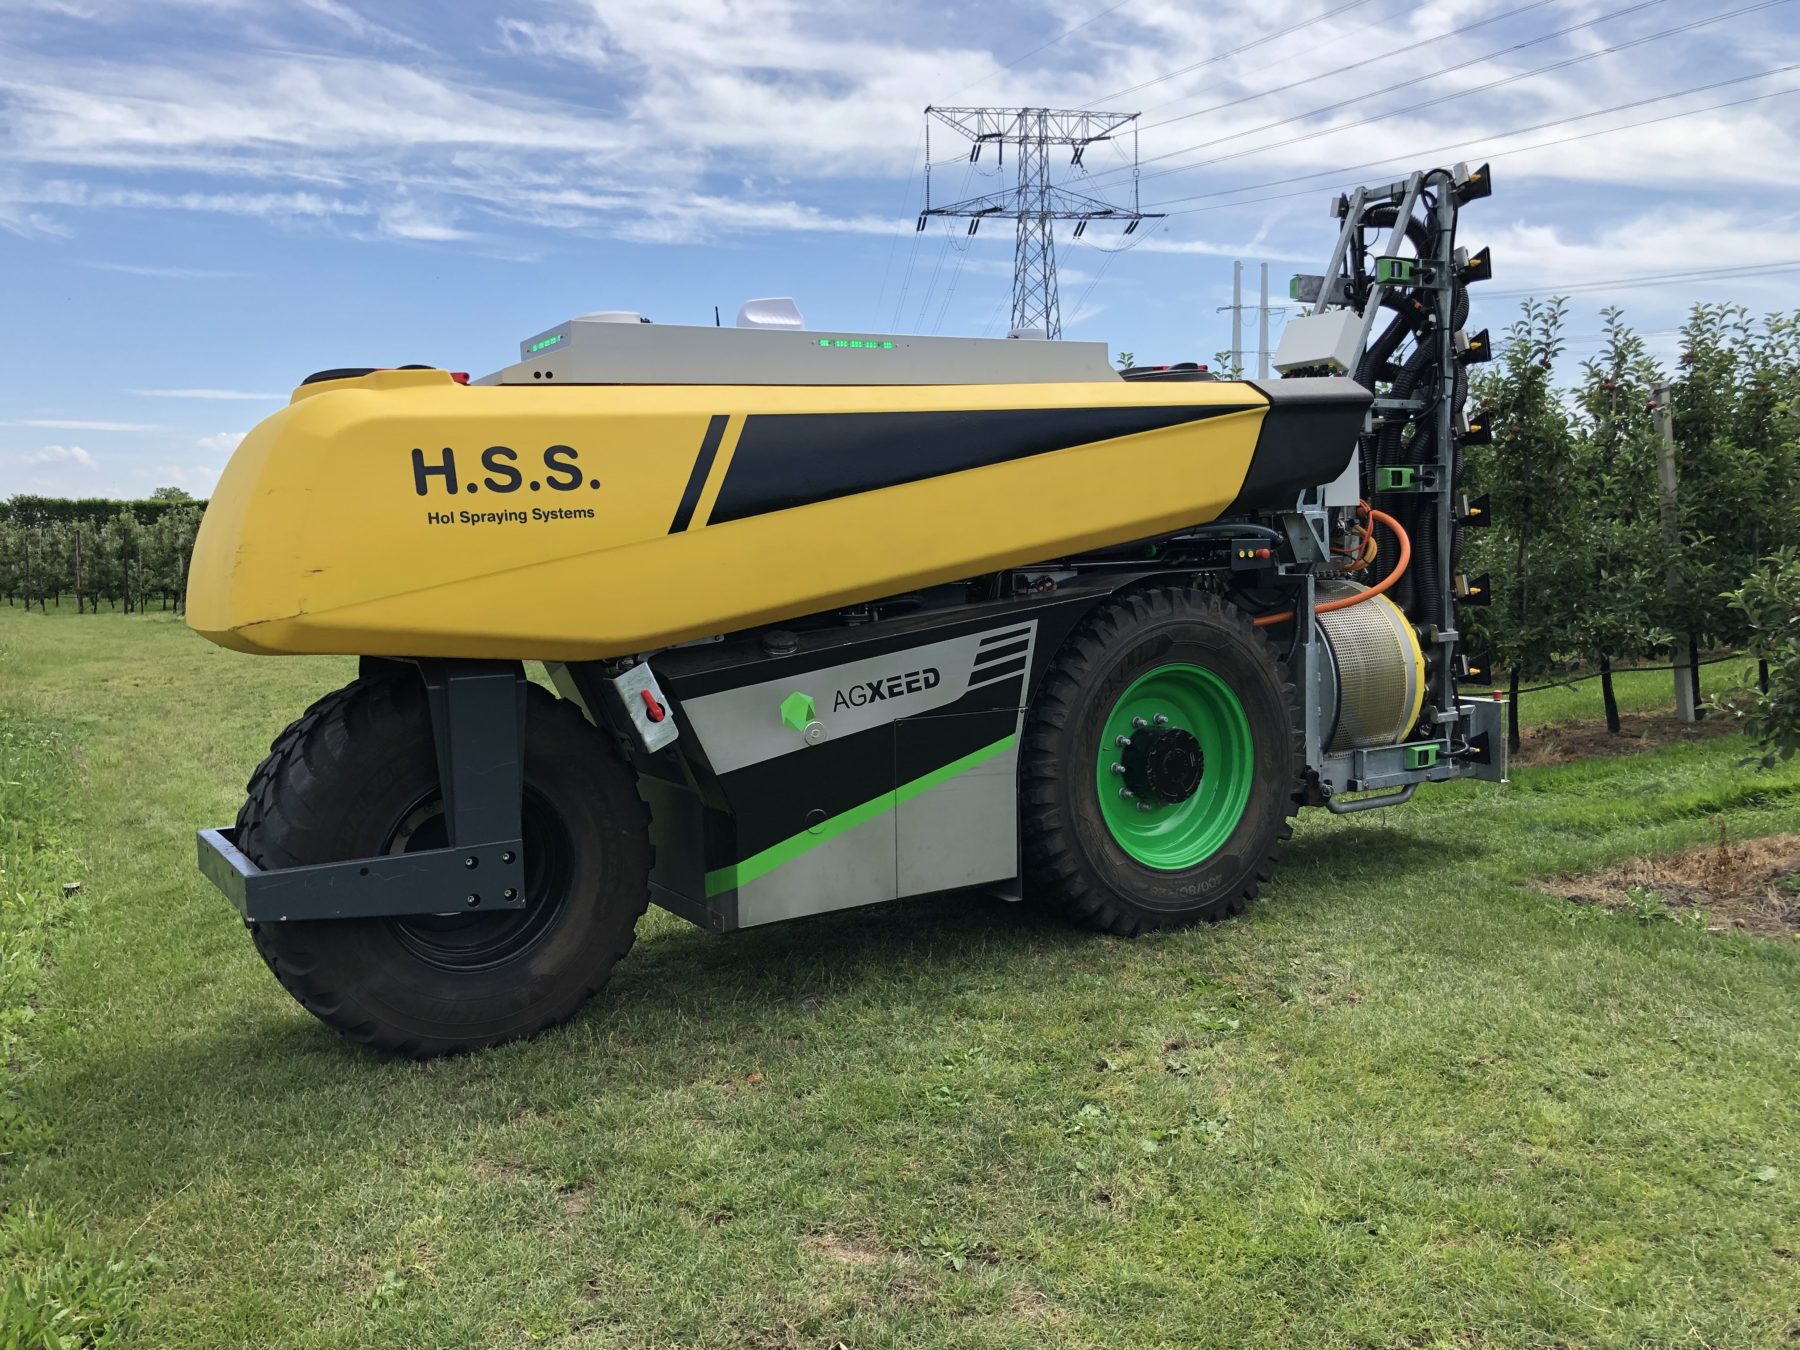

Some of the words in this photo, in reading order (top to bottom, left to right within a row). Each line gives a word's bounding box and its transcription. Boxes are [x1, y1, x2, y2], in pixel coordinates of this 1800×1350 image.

[412, 445, 600, 496] H.S.S.
[427, 511, 455, 525] Hol
[459, 508, 528, 527] Spraying
[531, 507, 595, 523] Systems
[833, 667, 941, 712] AGXEED
